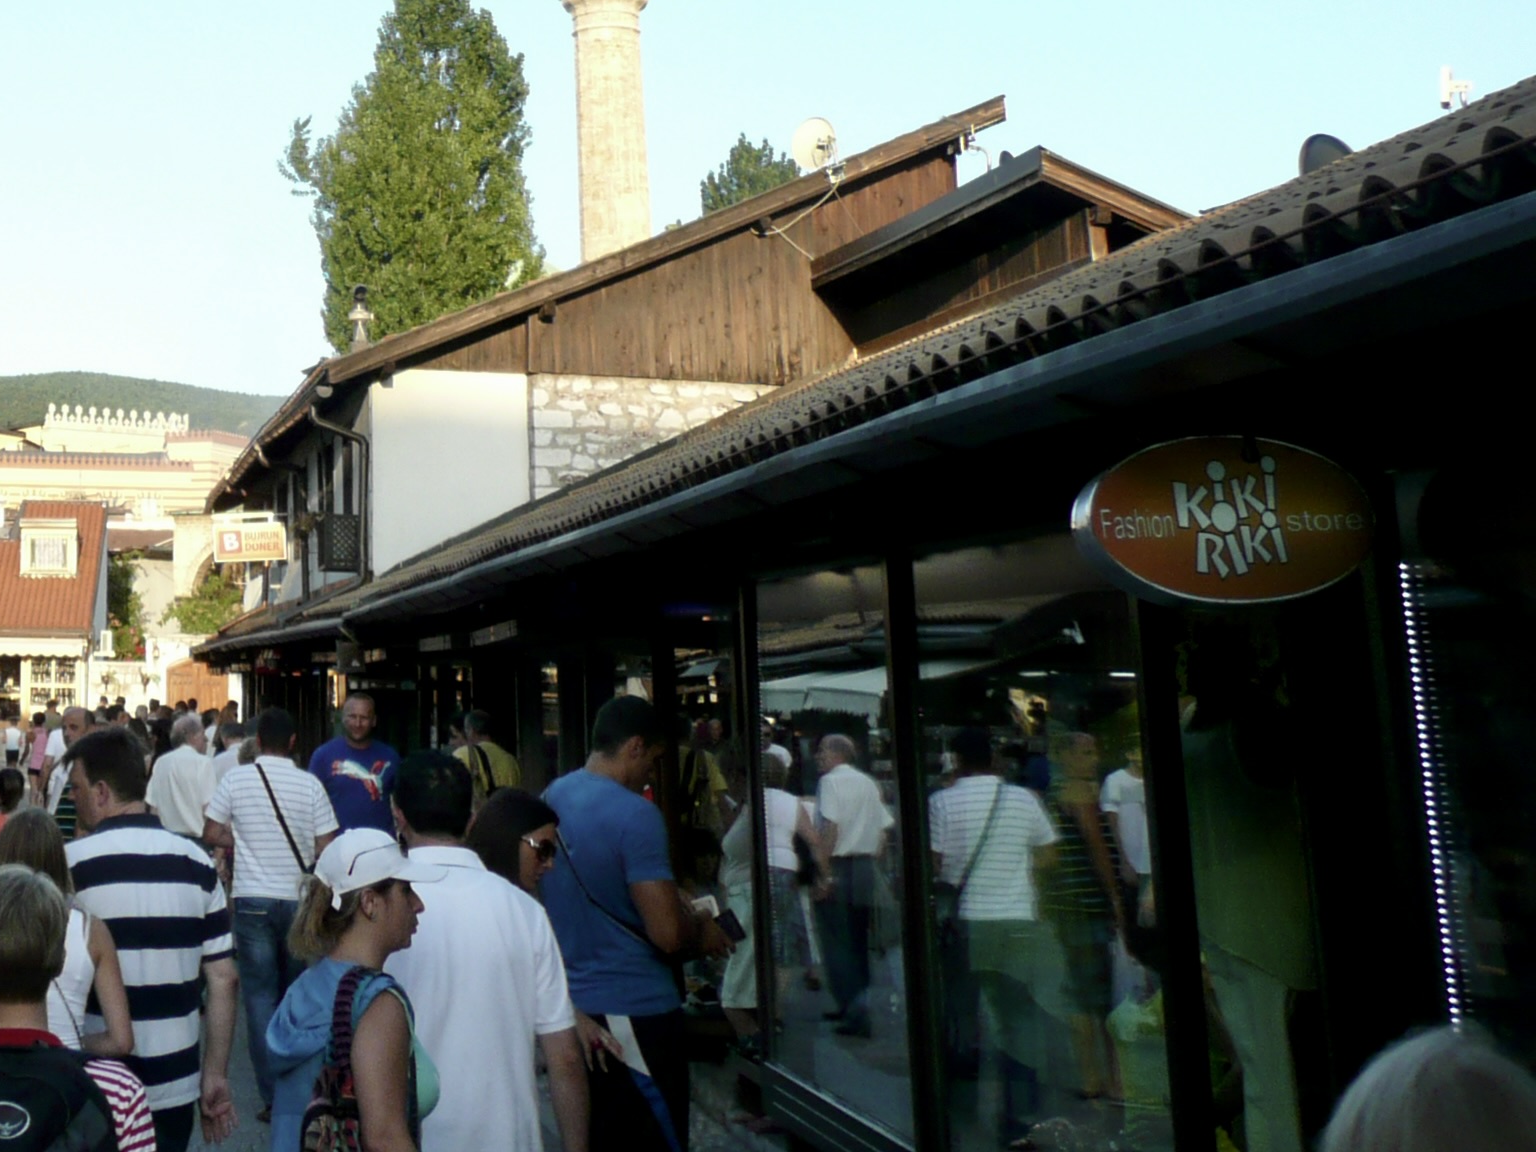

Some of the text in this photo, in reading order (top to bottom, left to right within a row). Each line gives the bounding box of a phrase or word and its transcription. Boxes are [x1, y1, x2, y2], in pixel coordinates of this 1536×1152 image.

[1100, 508, 1365, 540] Fashion store
[223, 533, 240, 552] B
